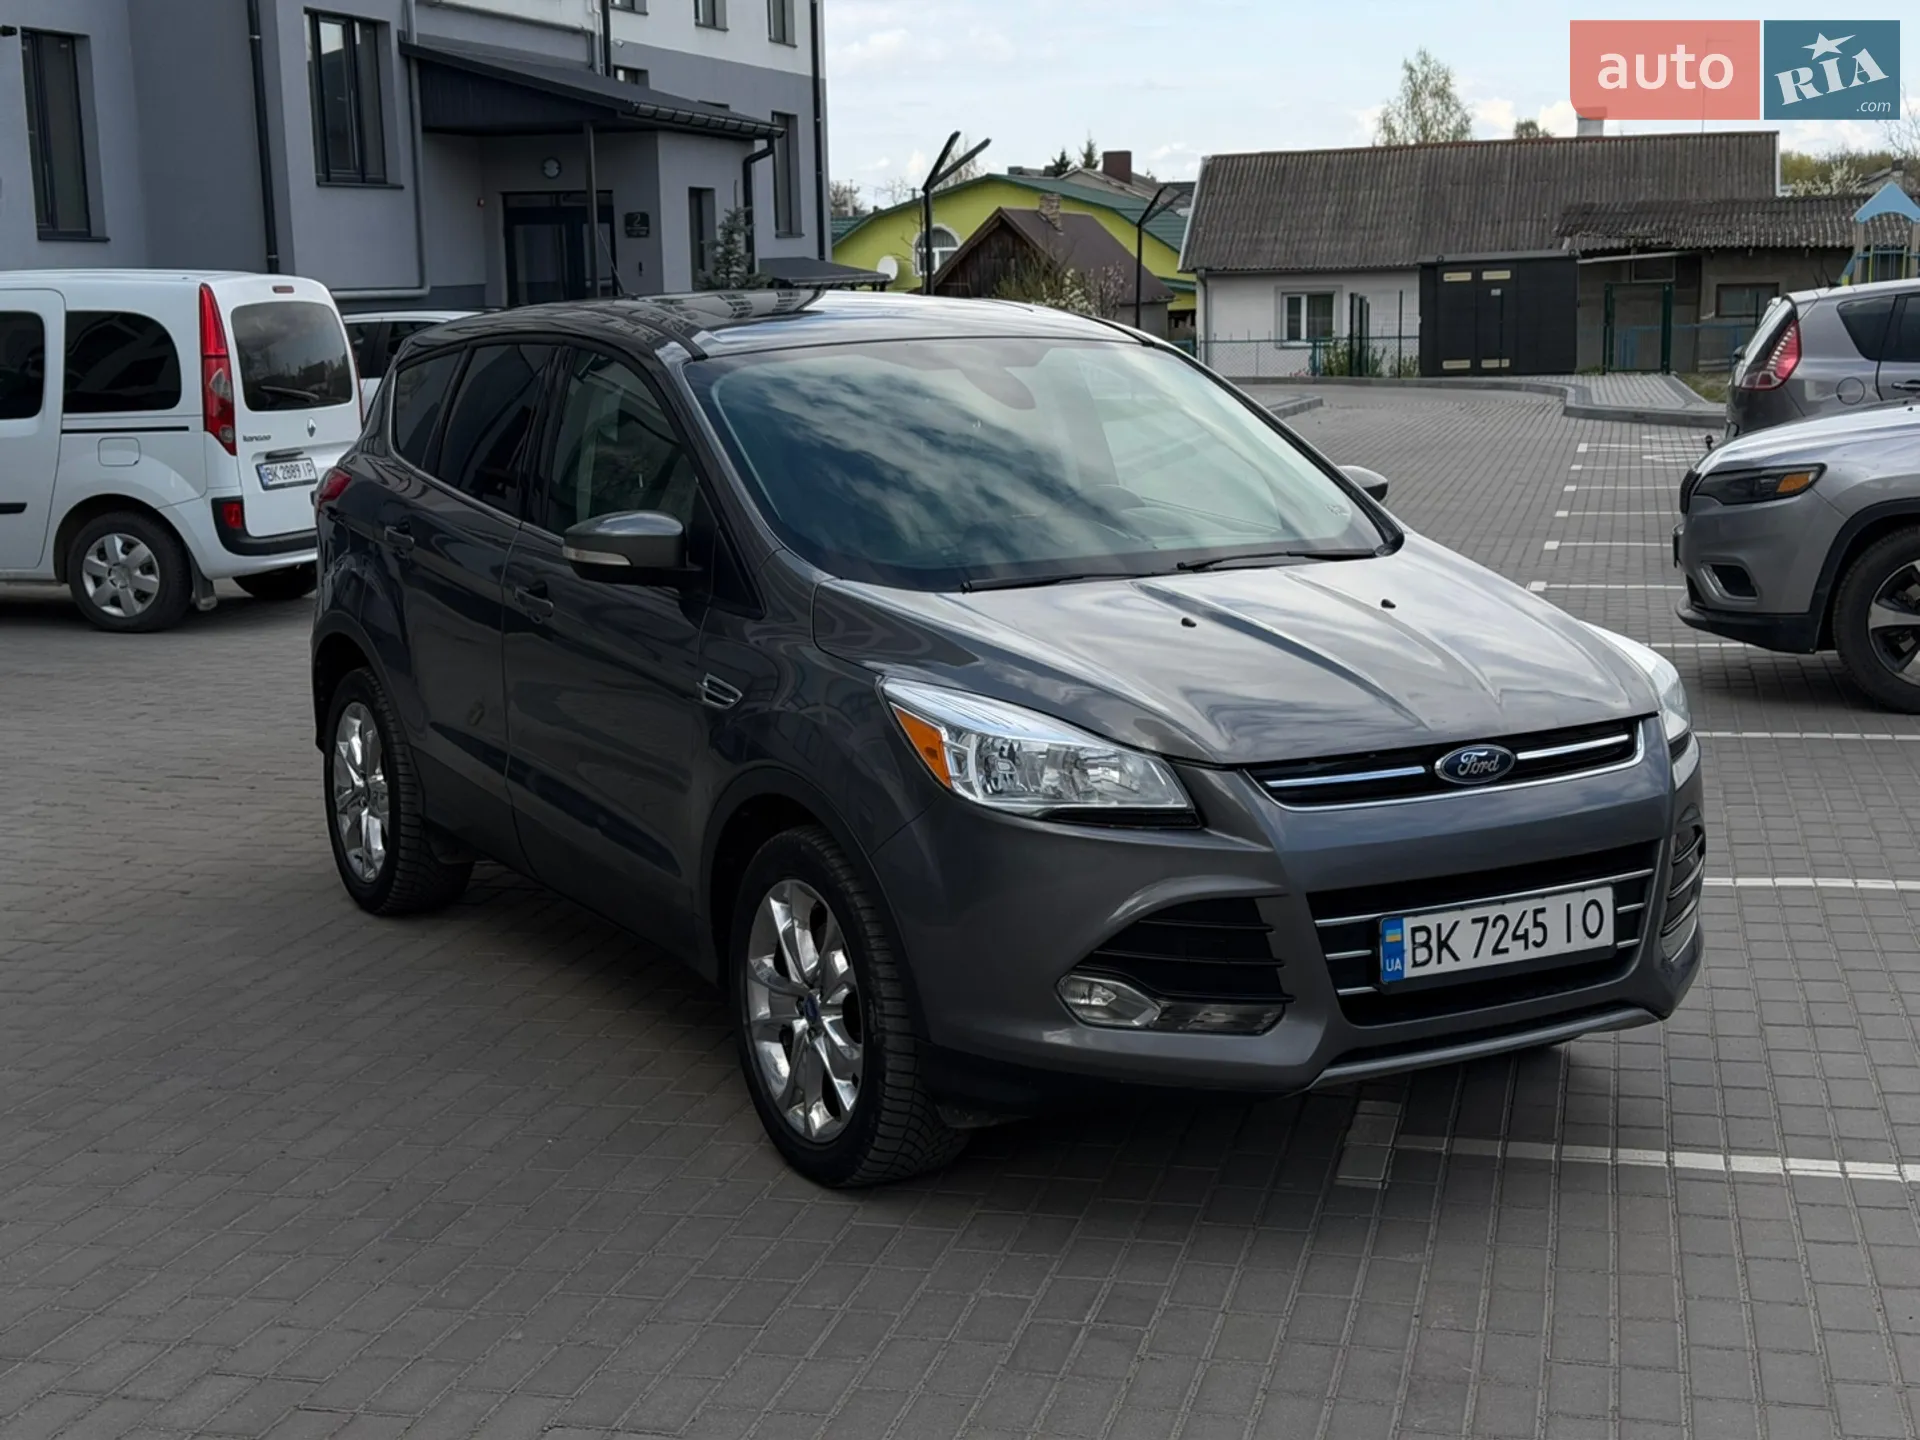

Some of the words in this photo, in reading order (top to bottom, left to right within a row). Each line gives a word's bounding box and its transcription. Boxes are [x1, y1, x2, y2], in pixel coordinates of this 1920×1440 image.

[265, 466, 281, 482] BK
[1457, 750, 1500, 776] Ford
[1409, 920, 1460, 969] BK
[1471, 906, 1549, 959] 7245
[1566, 898, 1604, 944] IO
[1385, 957, 1402, 972] UA
